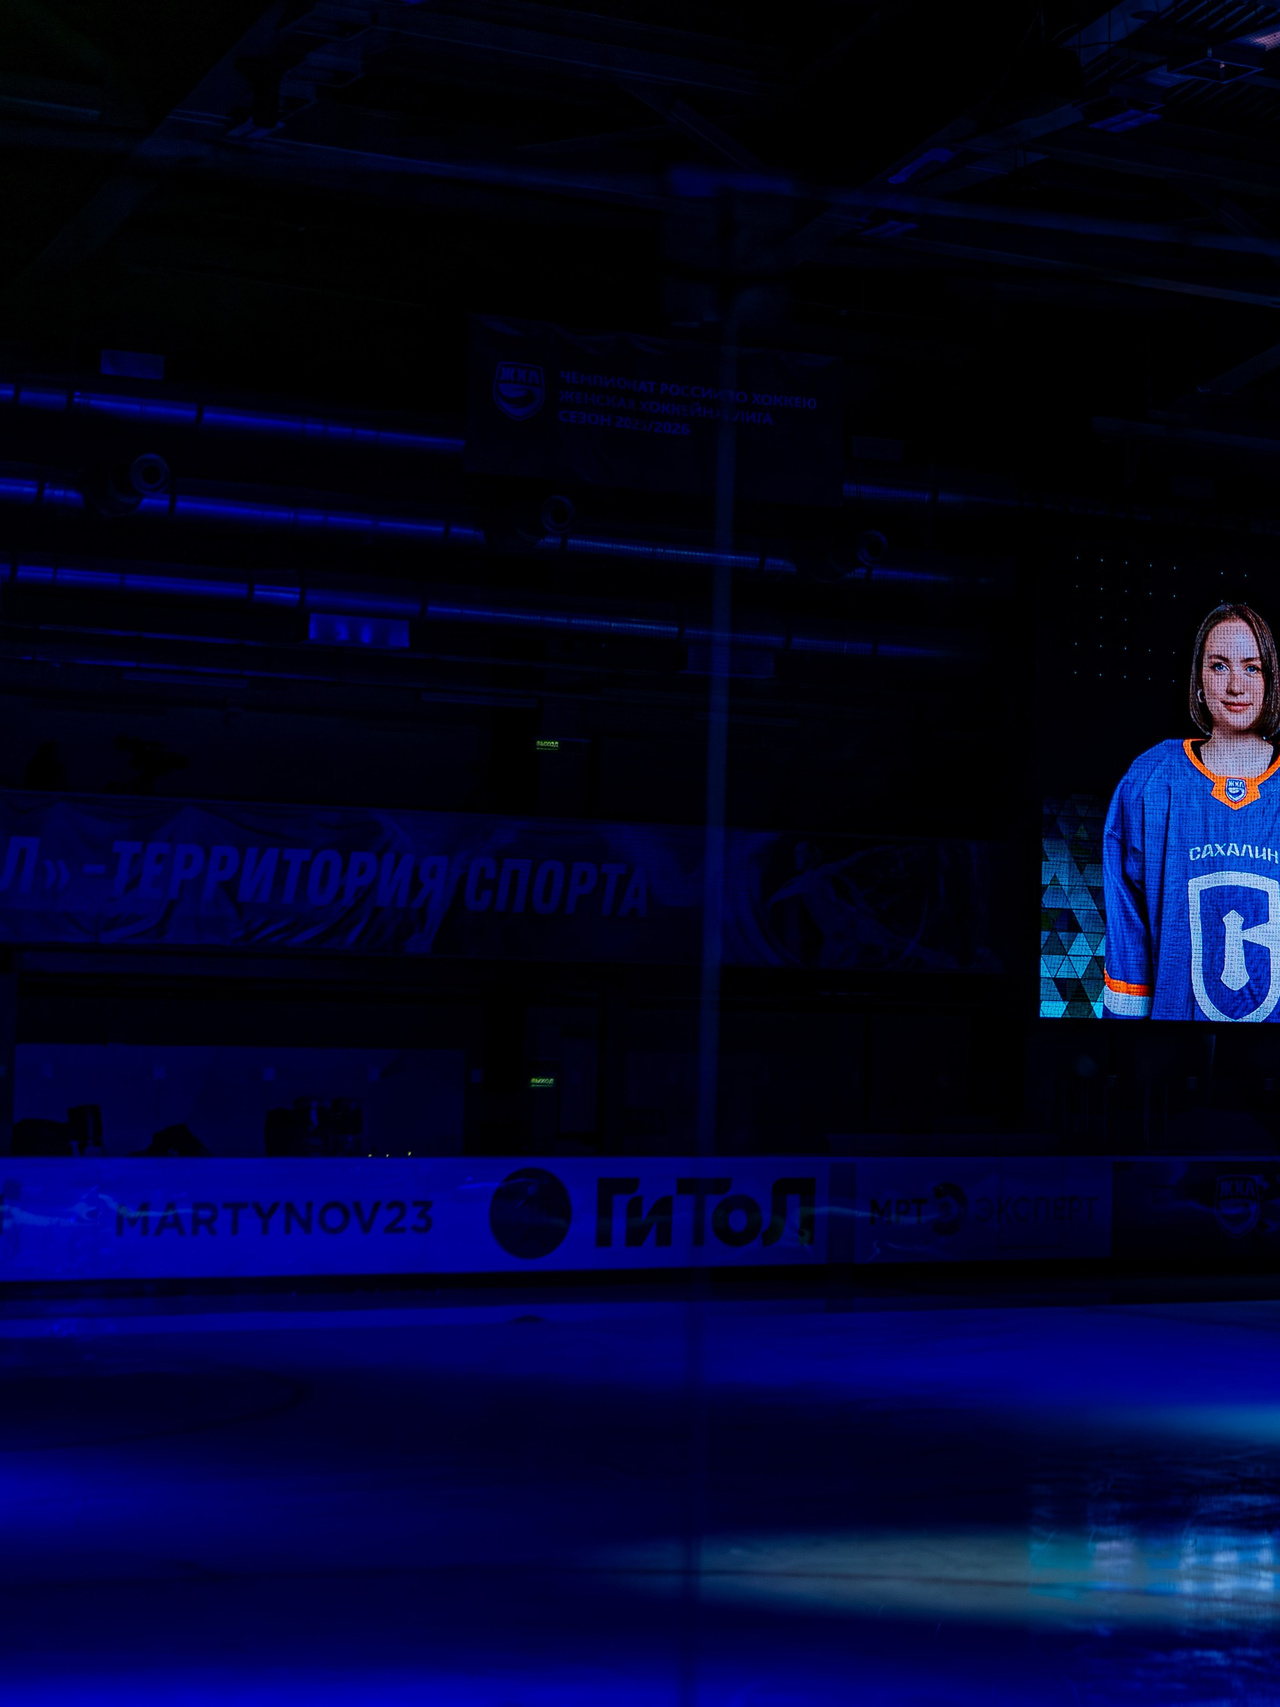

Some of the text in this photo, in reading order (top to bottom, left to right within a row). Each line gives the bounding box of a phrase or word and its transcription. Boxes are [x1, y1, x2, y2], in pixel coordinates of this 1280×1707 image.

[499, 366, 541, 386] ЖХЛ
[558, 389, 637, 409] ЖЕНСКАЯ
[559, 370, 657, 395] ЧЕМПИОНАТ
[751, 393, 817, 411] ХОККЕЮ
[557, 409, 691, 437] СЕЗОН 2025/2026
[1187, 842, 1280, 865] САХАЛИН
[463, 856, 649, 918] СПОРТА
[1219, 1179, 1256, 1197] ЖХЛ
[114, 1200, 434, 1237] MARTYNOV23
[869, 1195, 1100, 1226] МРТ ЭКСПЕРТ
